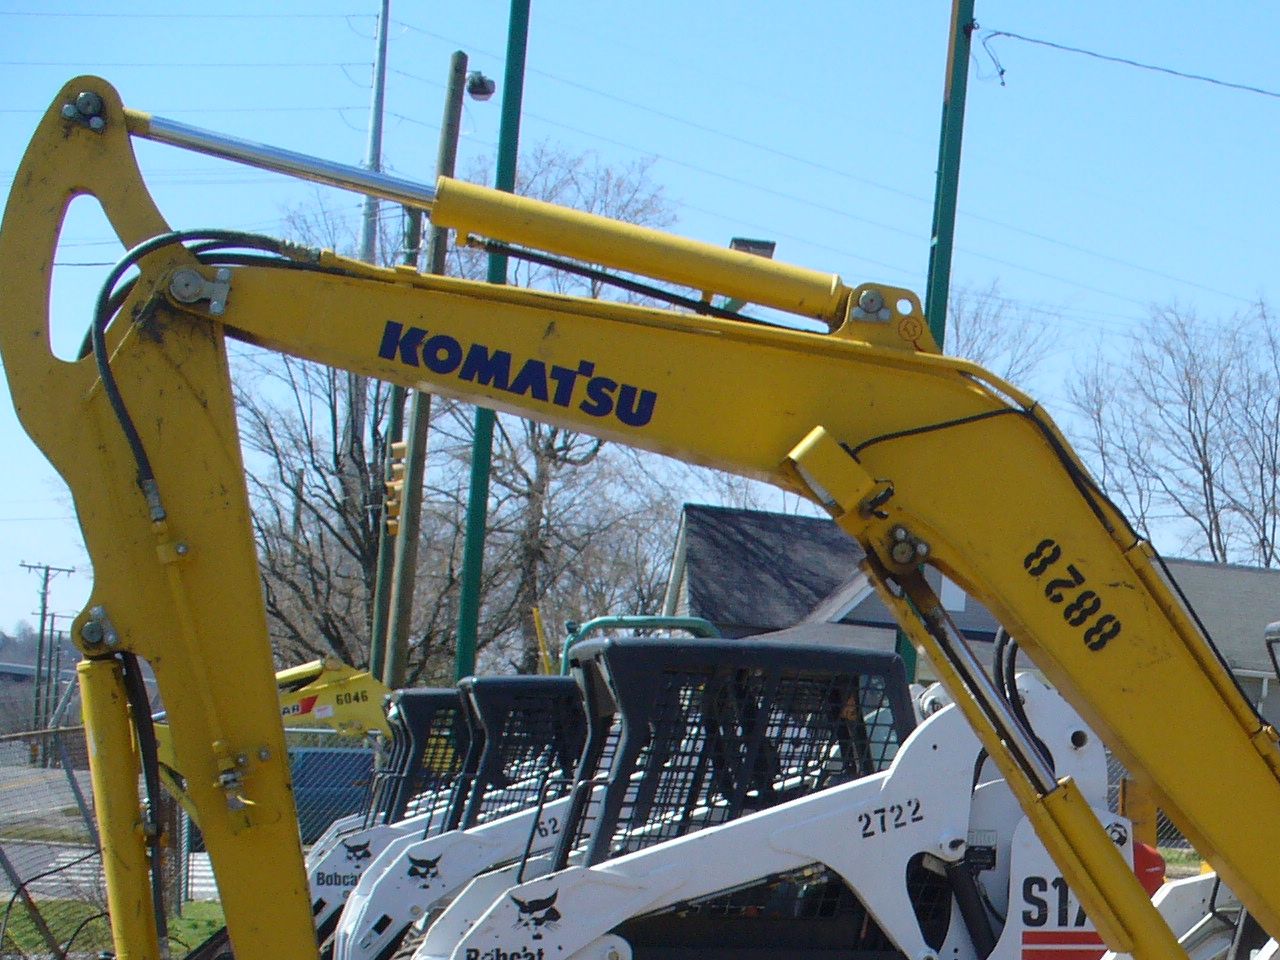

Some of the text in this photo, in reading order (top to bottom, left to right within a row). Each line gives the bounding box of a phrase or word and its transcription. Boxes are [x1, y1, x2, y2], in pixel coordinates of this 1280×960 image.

[378, 320, 657, 427] KOMATSU
[1024, 539, 1121, 651] 8828
[336, 691, 369, 706] 6046
[858, 798, 923, 838] 2722
